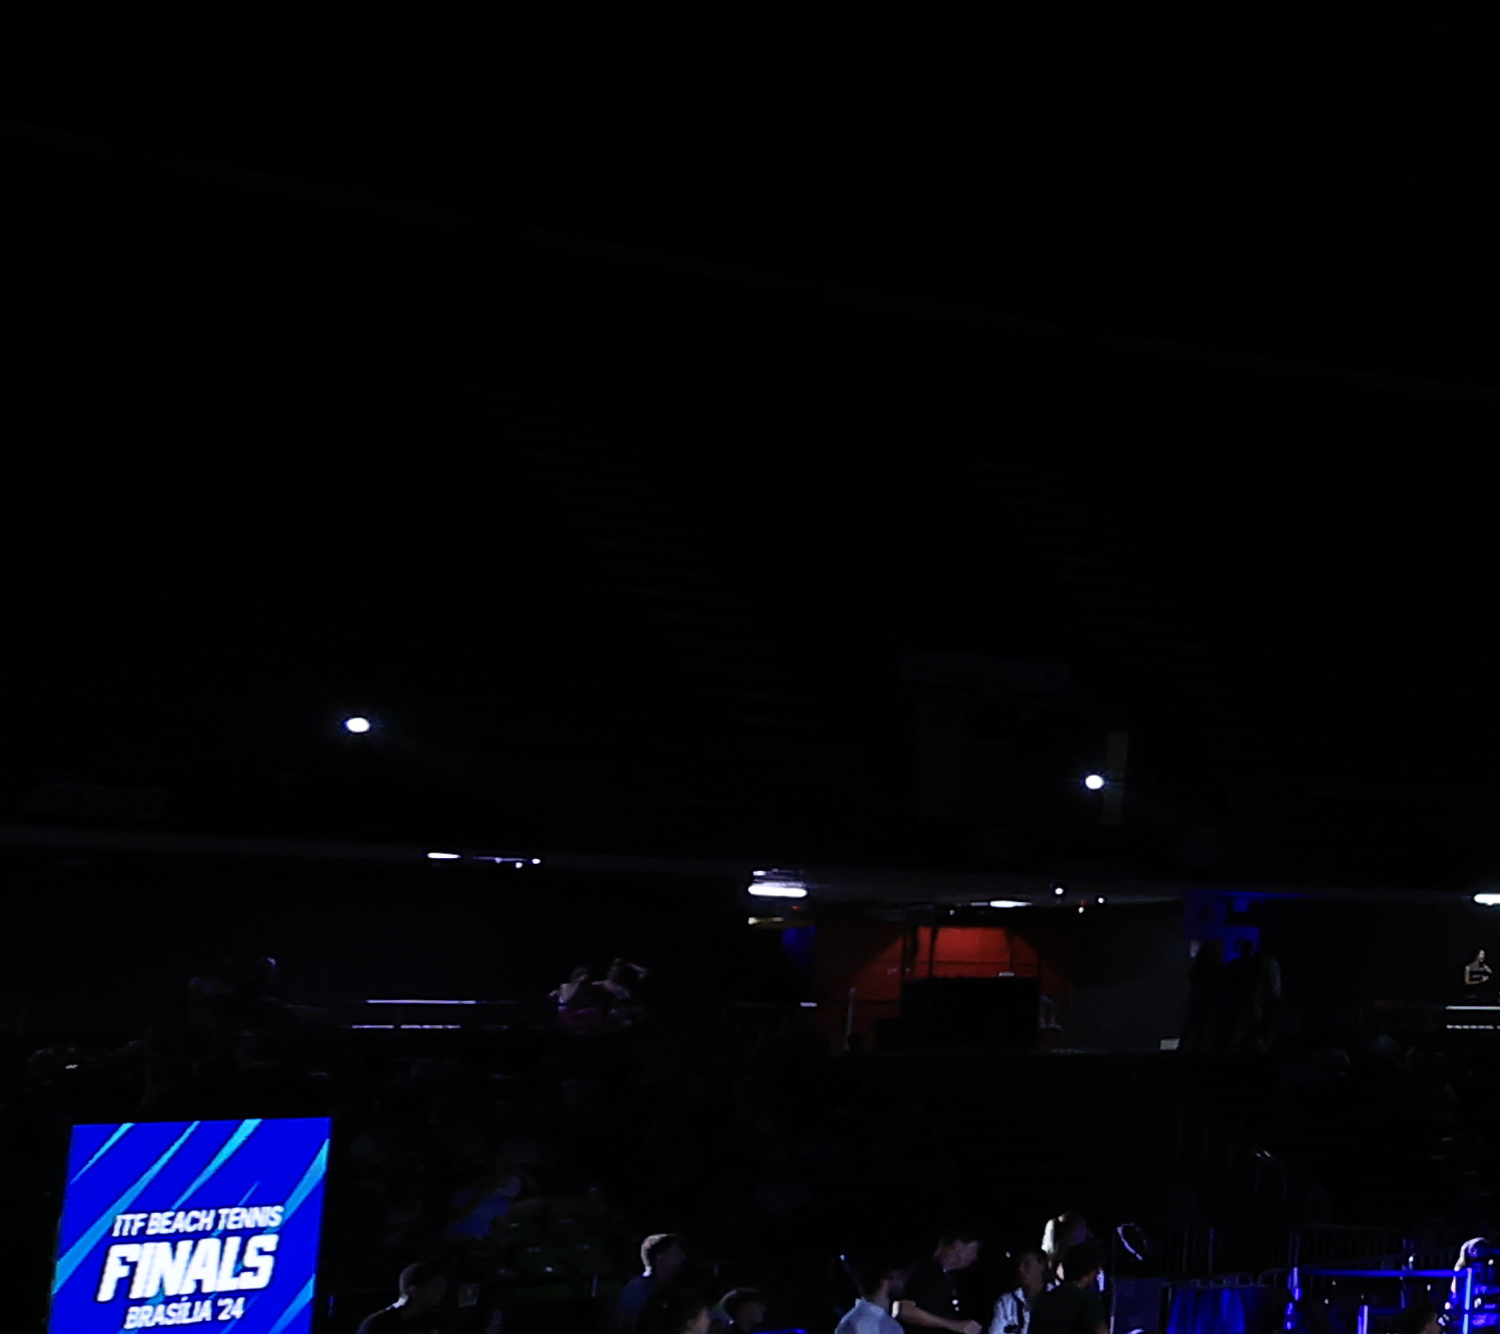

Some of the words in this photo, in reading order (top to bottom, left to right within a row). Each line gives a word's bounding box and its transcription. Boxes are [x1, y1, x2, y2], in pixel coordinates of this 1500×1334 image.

[111, 1213, 147, 1237] ITF
[146, 1209, 216, 1236] BEACH
[217, 1205, 285, 1231] TENNIS
[96, 1233, 280, 1302] FINALS
[123, 1296, 213, 1329] BRASÍLIA
